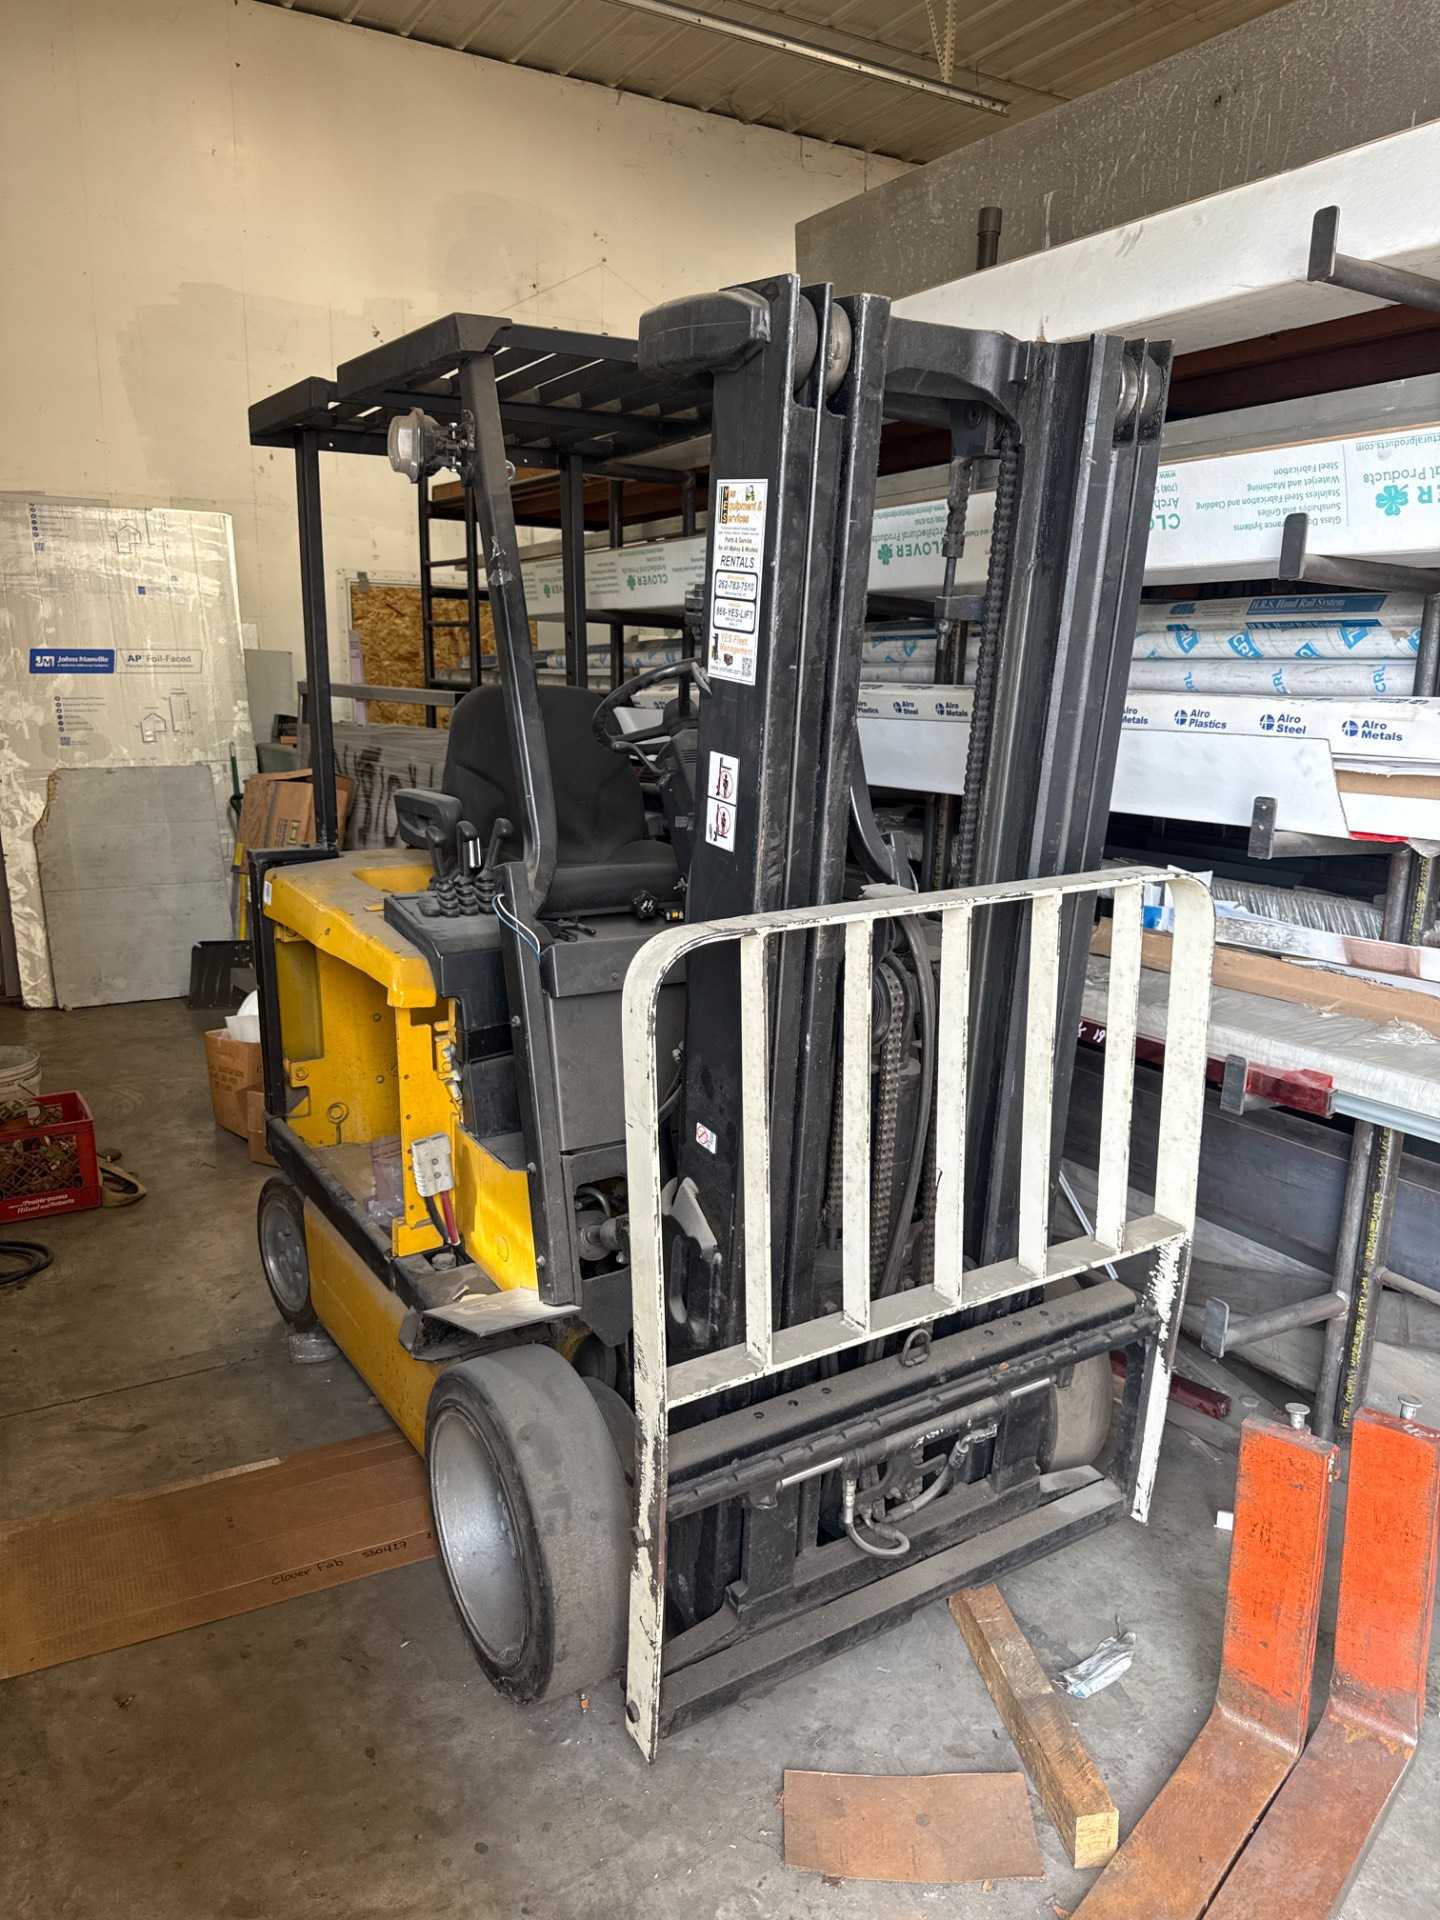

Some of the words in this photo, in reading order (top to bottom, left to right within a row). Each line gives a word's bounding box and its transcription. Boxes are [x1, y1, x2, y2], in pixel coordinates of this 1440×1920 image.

[1273, 463, 1318, 476] Fabrication
[1318, 460, 1339, 471] Steel
[1304, 474, 1340, 485] Waterjet
[1362, 465, 1427, 486] Products
[1247, 480, 1286, 492] Machining
[1287, 479, 1302, 488] and
[1283, 491, 1304, 501] Steel
[1305, 488, 1341, 499] Stainless
[1227, 499, 1241, 508] and
[1242, 494, 1282, 505] Fabrication
[1196, 501, 1226, 511] Cladding
[1282, 505, 1298, 515] and
[1299, 502, 1341, 513] Sunshades
[1257, 507, 1282, 517] Grilles
[1320, 515, 1342, 525] Glass
[1233, 522, 1263, 532] Systems
[896, 540, 944, 558] LOVER
[720, 555, 755, 569] RENTALS
[636, 573, 669, 586] CLOVER
[1298, 598, 1315, 608] Rail
[1315, 598, 1345, 609] System
[146, 654, 192, 663] Foil-Faced
[1373, 665, 1386, 693] CRL
[1190, 709, 1210, 718] Alro
[1277, 714, 1301, 724] Alro
[1188, 718, 1227, 730] Plastics
[1276, 724, 1307, 735] Steel
[1361, 720, 1387, 730] Alro
[1361, 730, 1403, 742] Metals
[316, 1558, 344, 1573] Fab
